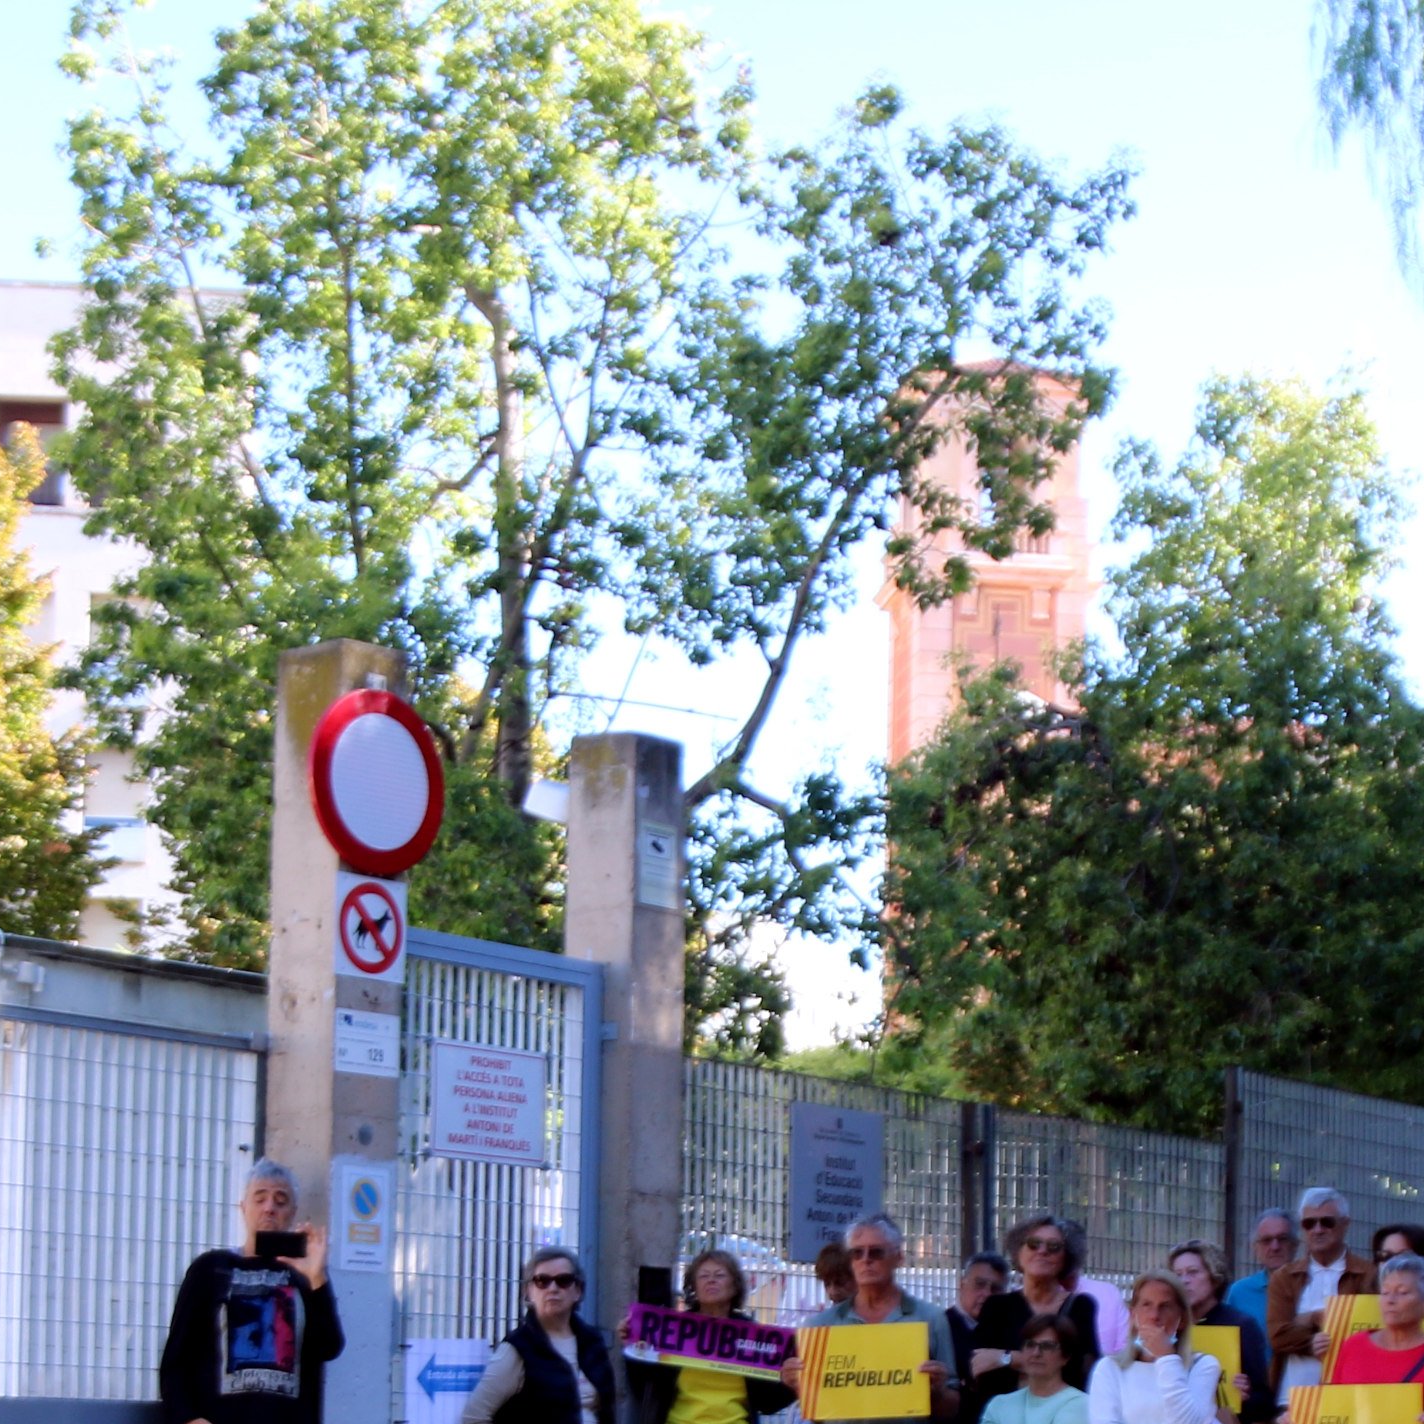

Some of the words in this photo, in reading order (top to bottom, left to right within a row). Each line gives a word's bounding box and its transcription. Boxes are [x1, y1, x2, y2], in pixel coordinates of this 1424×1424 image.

[470, 1055, 512, 1069] PROHIBIT
[494, 1075, 500, 1084] A
[502, 1075, 524, 1087] TOTA
[453, 1085, 495, 1099] PERSONA
[497, 1092, 527, 1104] ALIENA
[464, 1103, 470, 1112] A
[472, 1104, 518, 1118] L'INSTITUT
[467, 1119, 500, 1132] ANTONI
[503, 1123, 514, 1134] DE
[826, 1354, 856, 1370] FEM
[823, 1367, 913, 1388] REPÚBLICA
